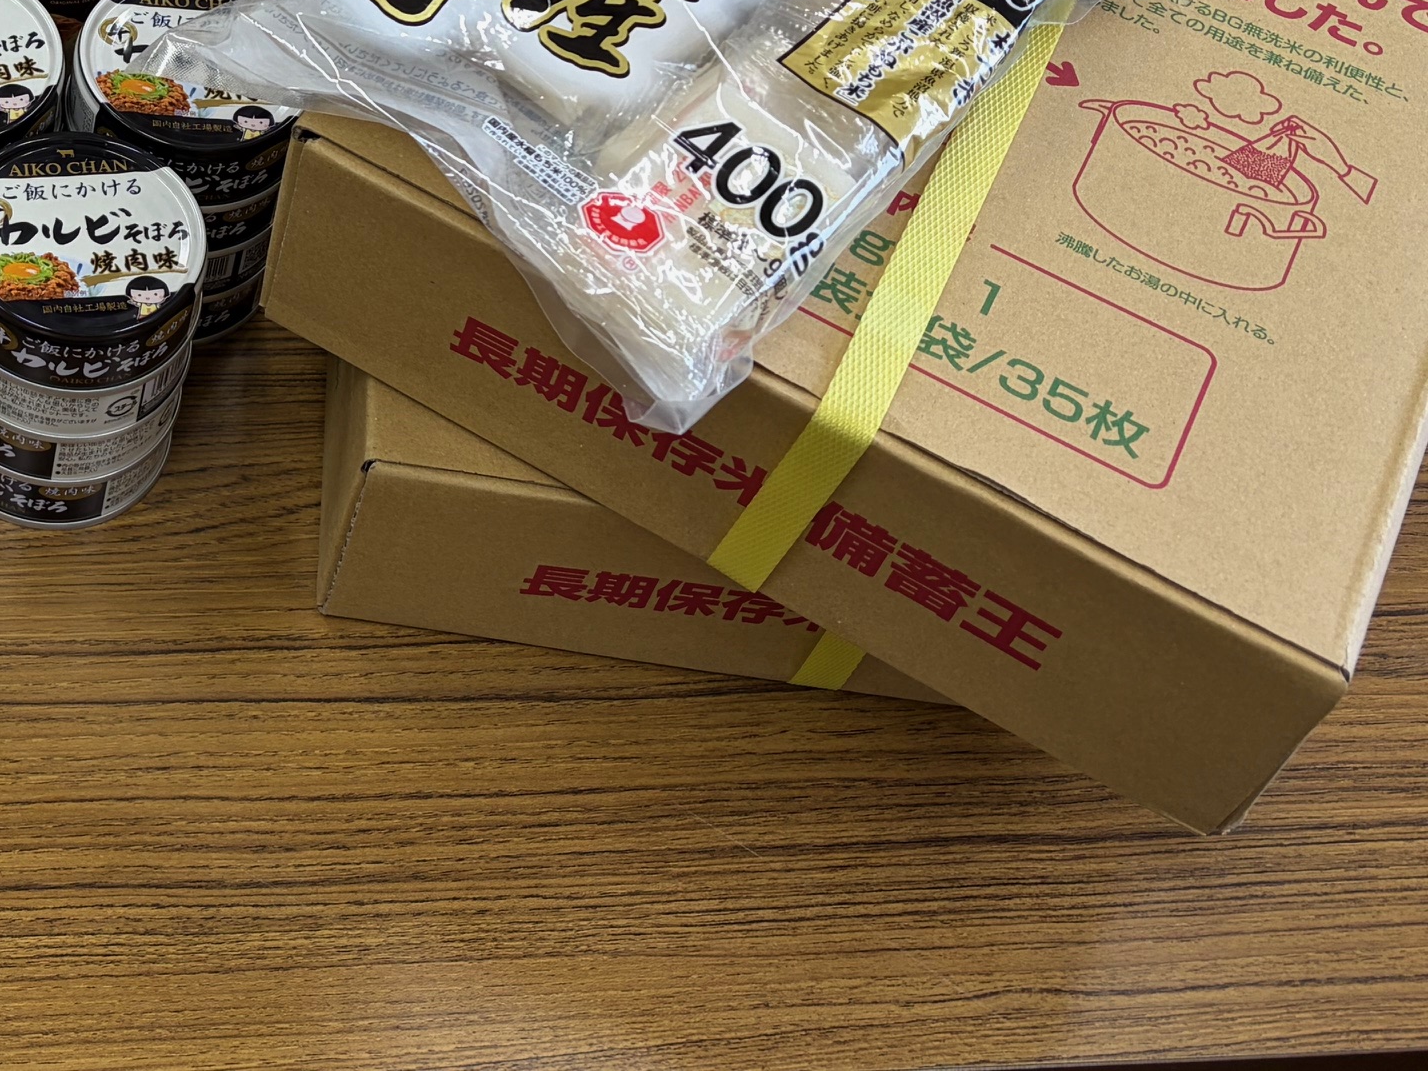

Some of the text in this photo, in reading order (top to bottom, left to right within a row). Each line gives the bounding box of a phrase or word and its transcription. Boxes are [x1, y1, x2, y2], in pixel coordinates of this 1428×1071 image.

[8, 160, 128, 177] AIKO CHAN
[2, 179, 141, 201] ご飯にかける
[91, 247, 180, 274] 焼肉味
[1055, 231, 1278, 346] 沸騰したお湯の中に入れる。
[12, 342, 169, 378] カルビそぼろ
[23, 337, 140, 360] ご飯にかける
[45, 486, 96, 497] 焼肉味
[803, 501, 1064, 672] 備蓄王
